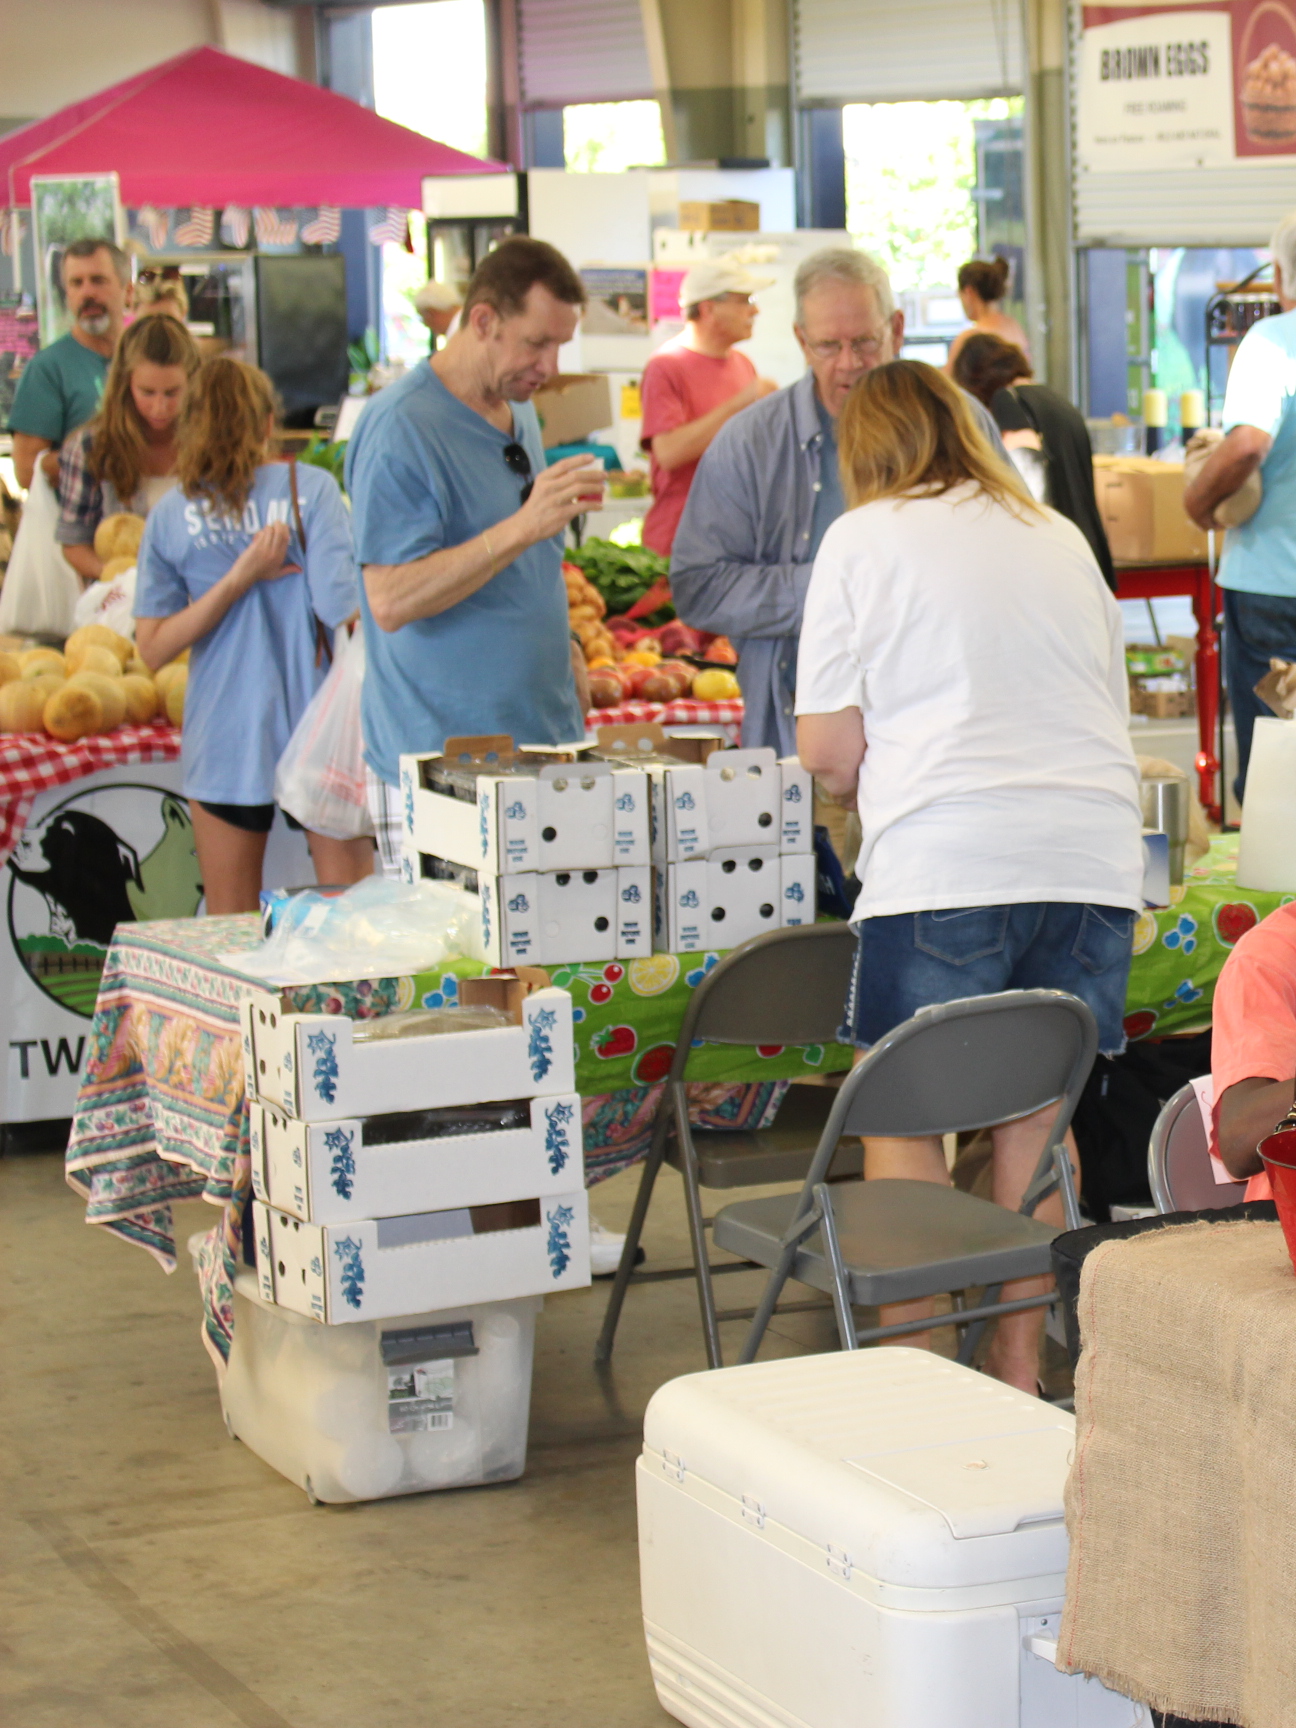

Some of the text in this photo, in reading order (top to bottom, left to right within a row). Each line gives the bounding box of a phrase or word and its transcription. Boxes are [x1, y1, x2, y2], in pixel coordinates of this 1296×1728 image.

[1101, 41, 1210, 80] BROWN EGGS
[9, 1036, 86, 1078] TW
